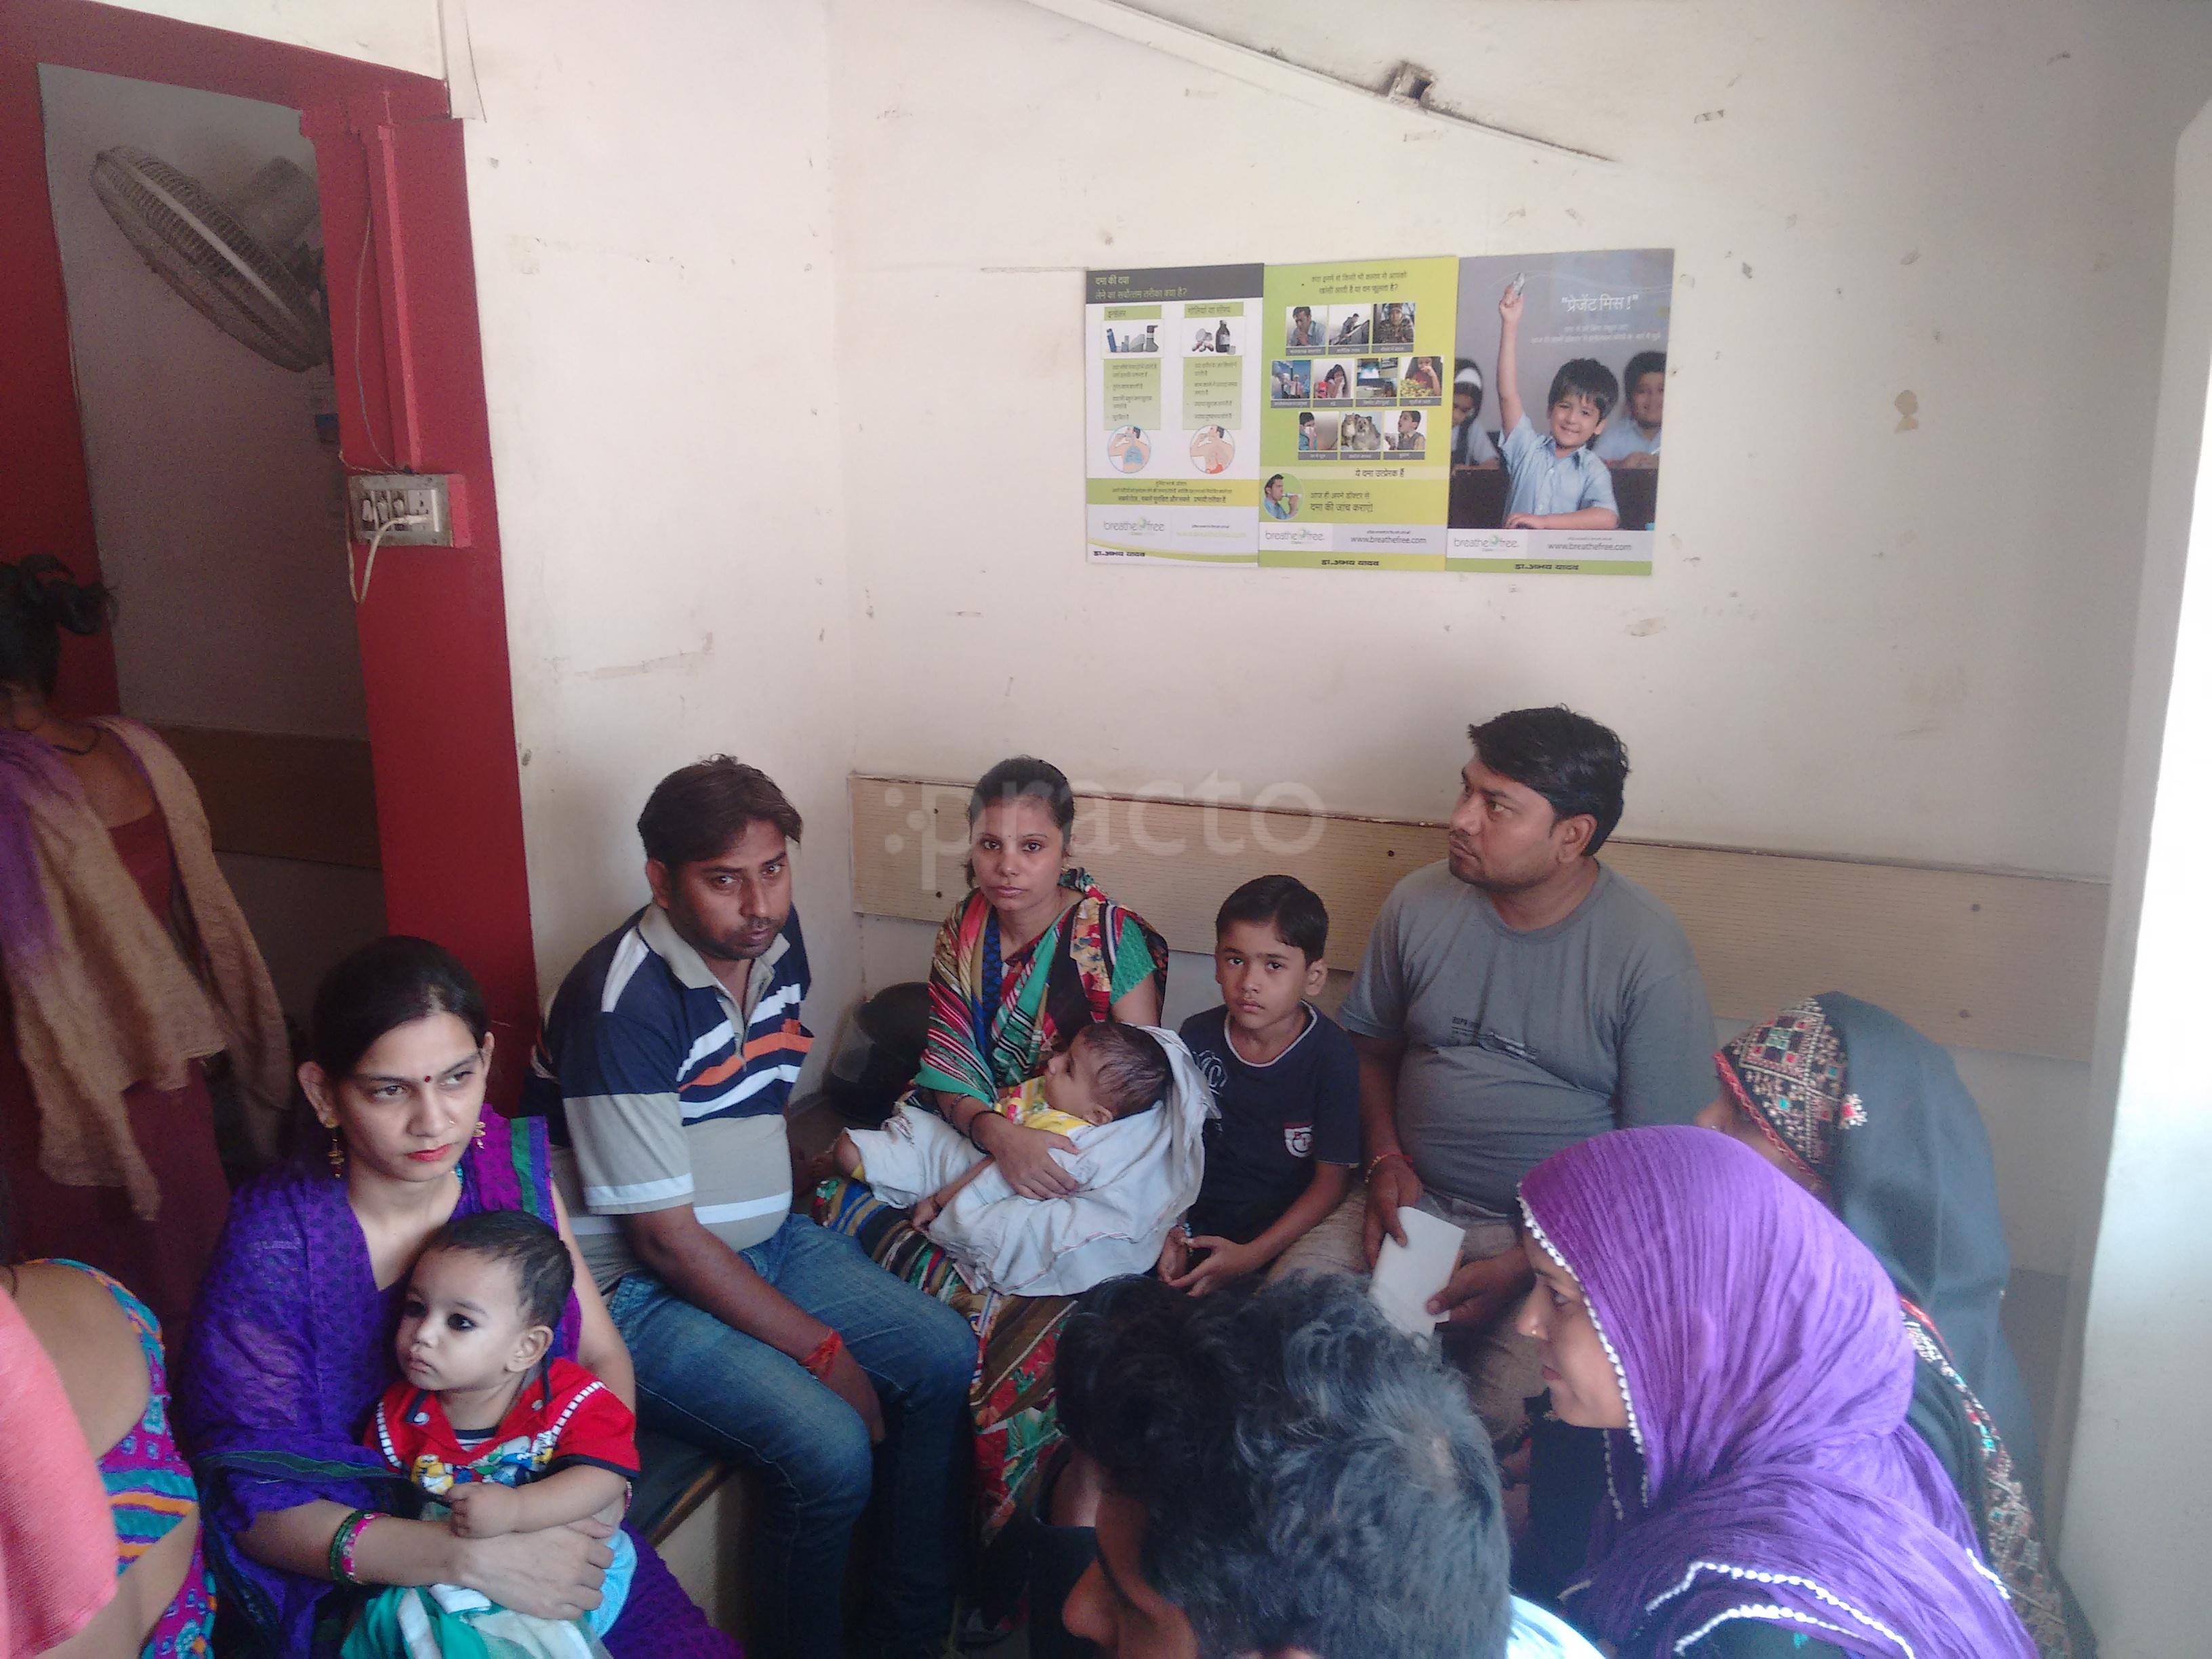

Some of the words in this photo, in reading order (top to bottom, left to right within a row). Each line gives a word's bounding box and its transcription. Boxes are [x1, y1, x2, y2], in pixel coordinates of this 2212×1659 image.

[1108, 274, 1117, 285] की
[1118, 276, 1130, 284] दवा
[1311, 503, 1323, 511] दमा
[1325, 501, 1334, 511] की
